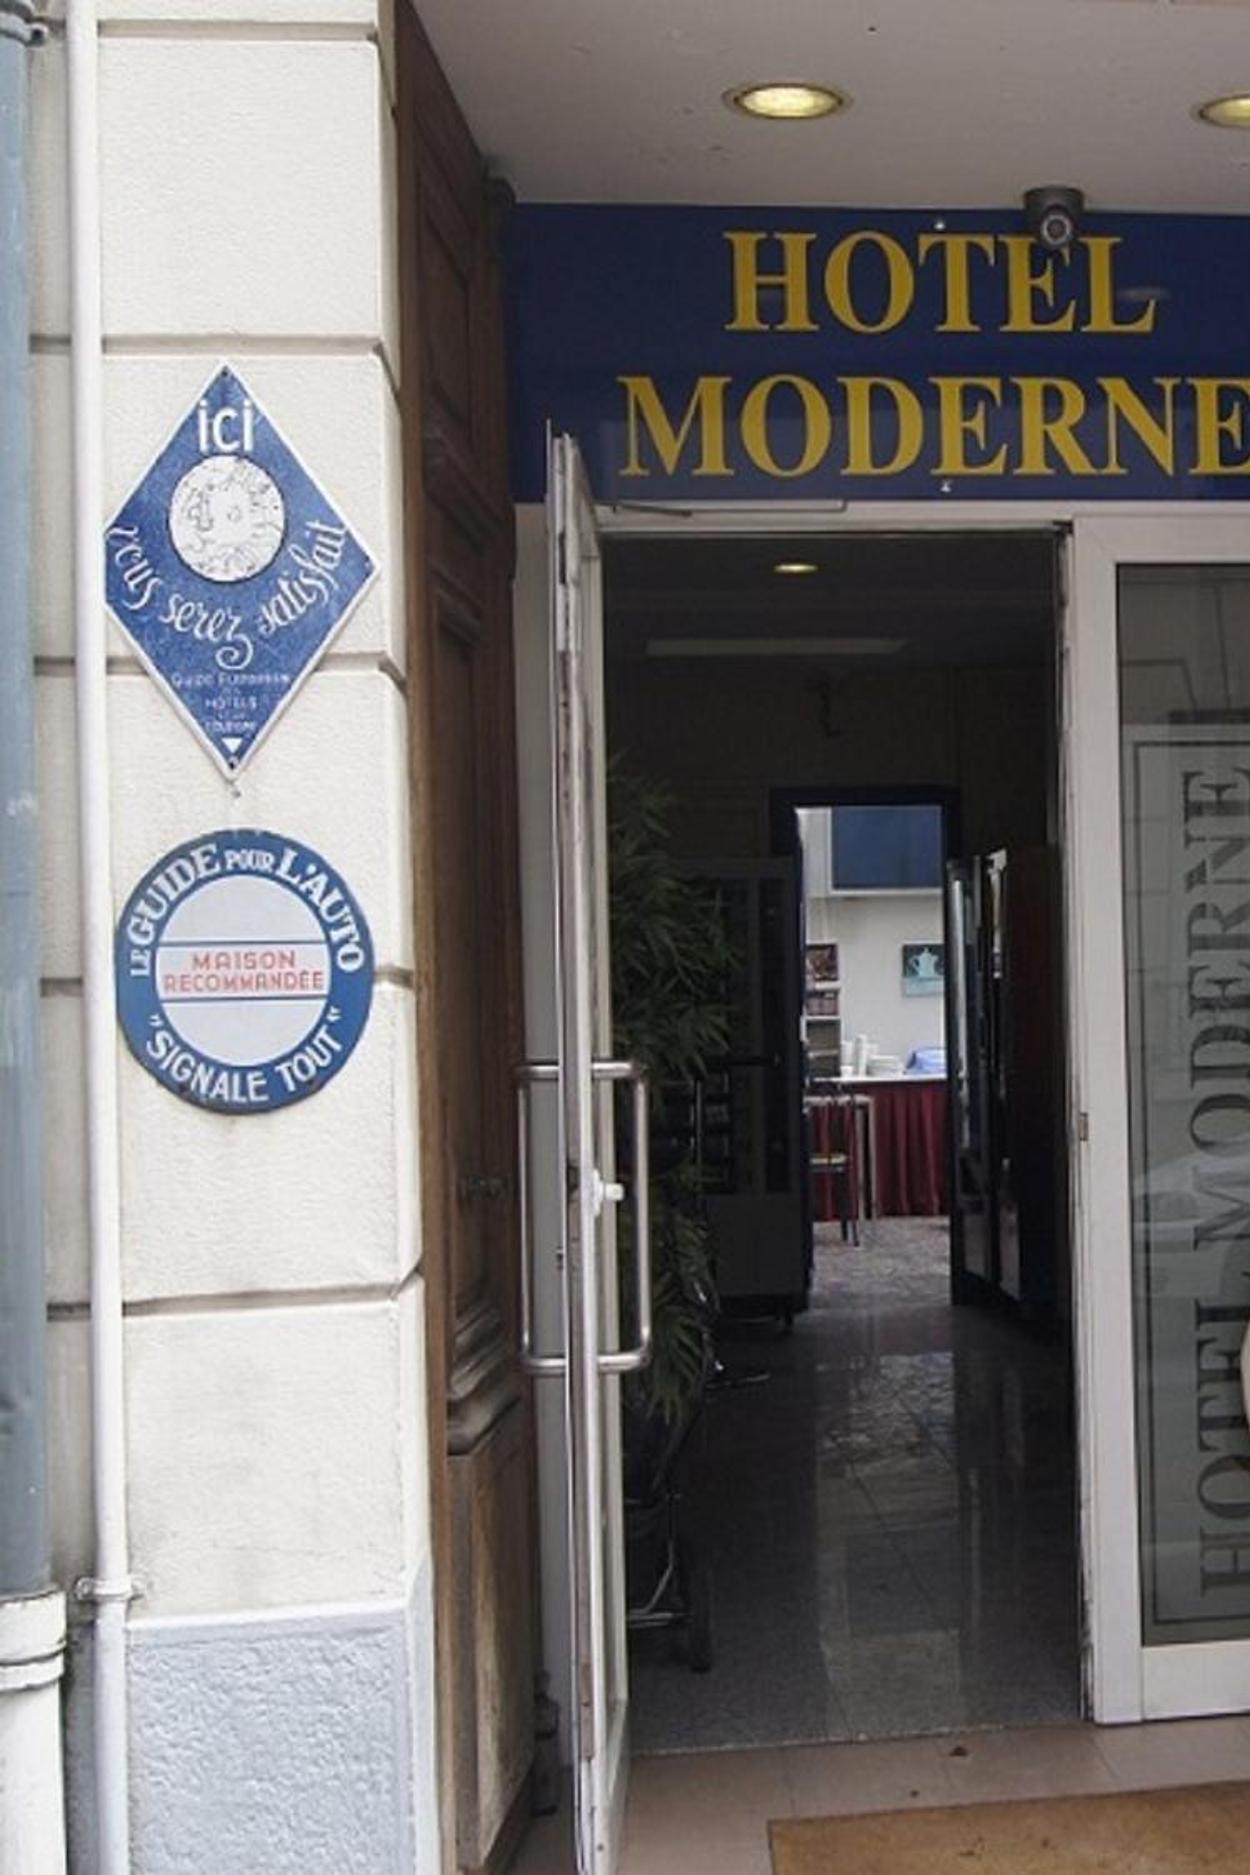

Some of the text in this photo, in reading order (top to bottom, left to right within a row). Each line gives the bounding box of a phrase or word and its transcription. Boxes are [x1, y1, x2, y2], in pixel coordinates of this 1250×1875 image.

[723, 230, 1159, 335] HOTEL
[158, 592, 254, 670] serez
[257, 519, 348, 635] satisfait
[126, 843, 365, 978] LE GUIDE POUR L'AUTO
[191, 949, 297, 971] MAISON
